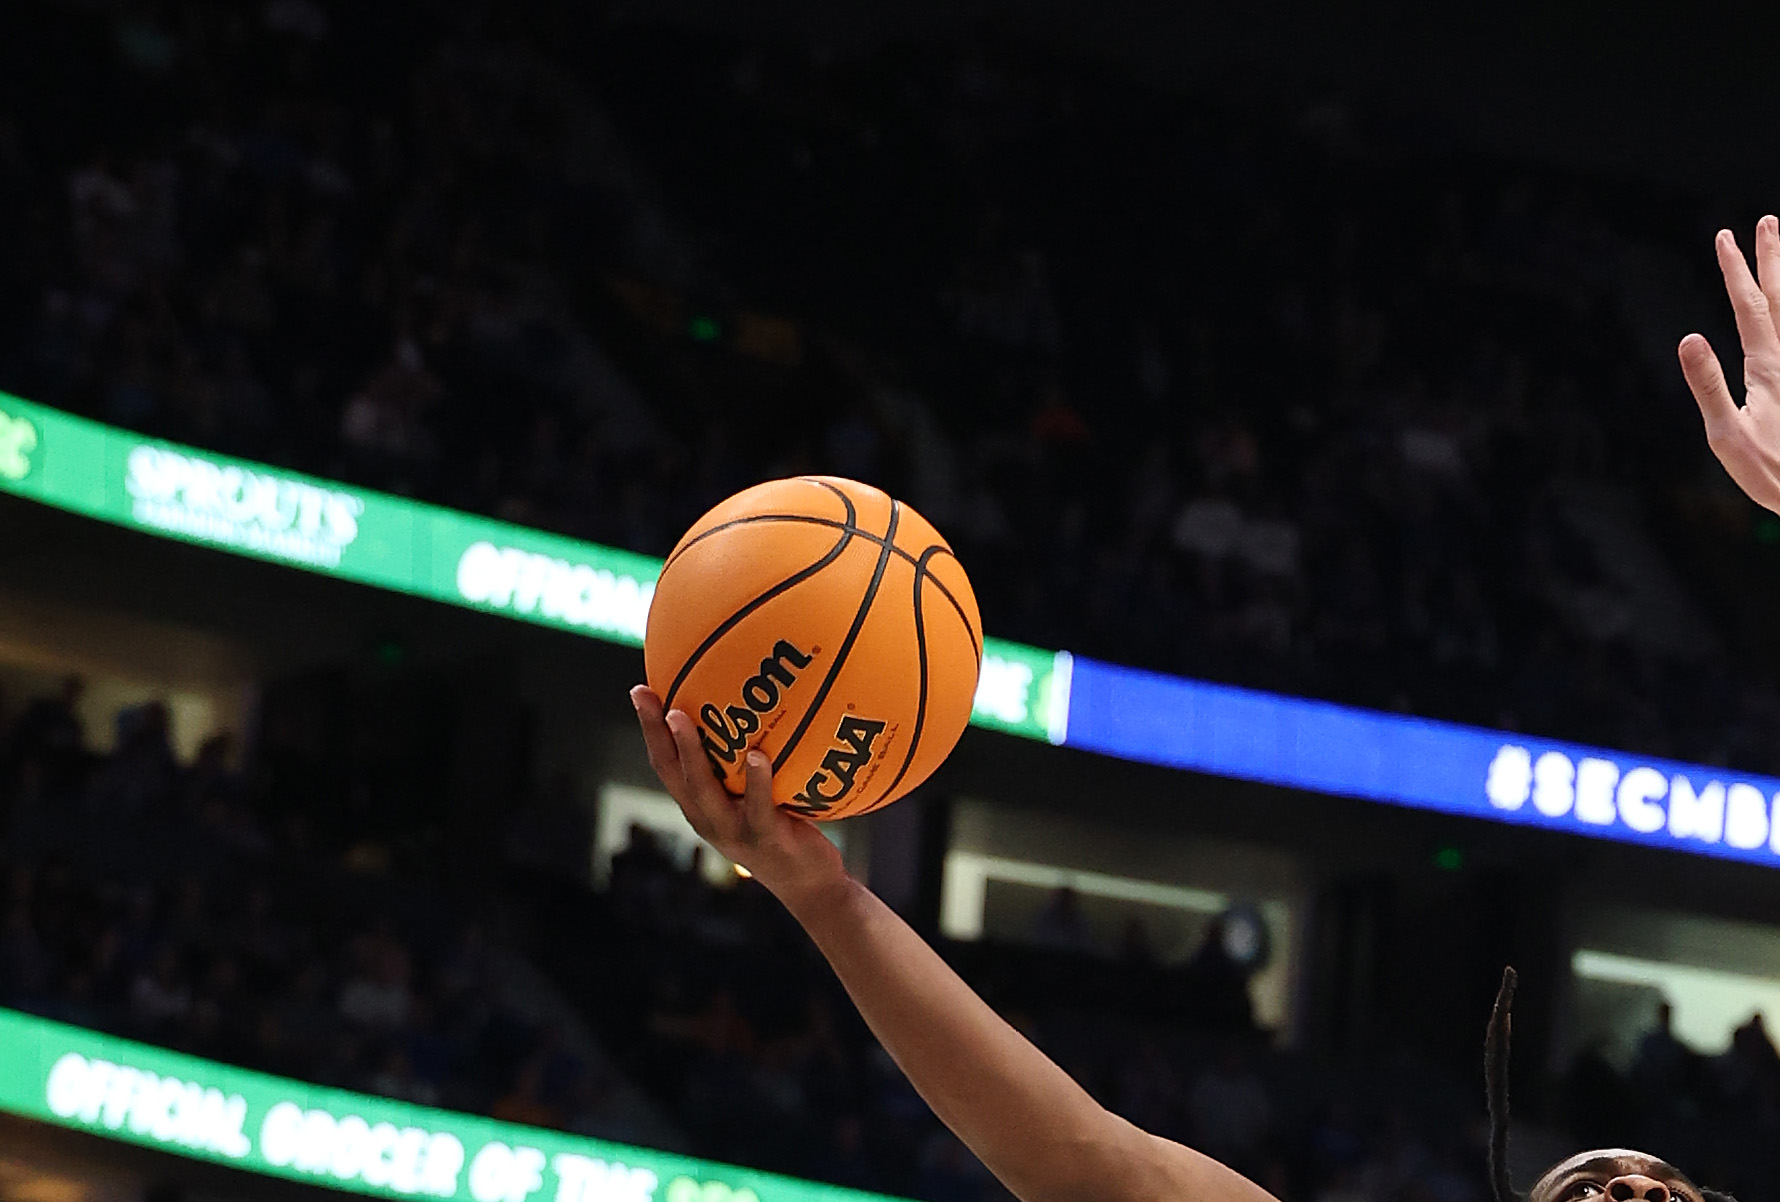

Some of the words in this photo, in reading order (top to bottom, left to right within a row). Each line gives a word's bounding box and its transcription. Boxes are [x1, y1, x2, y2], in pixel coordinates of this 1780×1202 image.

[697, 639, 812, 778] ilson
[46, 1052, 251, 1158] OFFICIAL
[260, 1102, 465, 1198] GROCER
